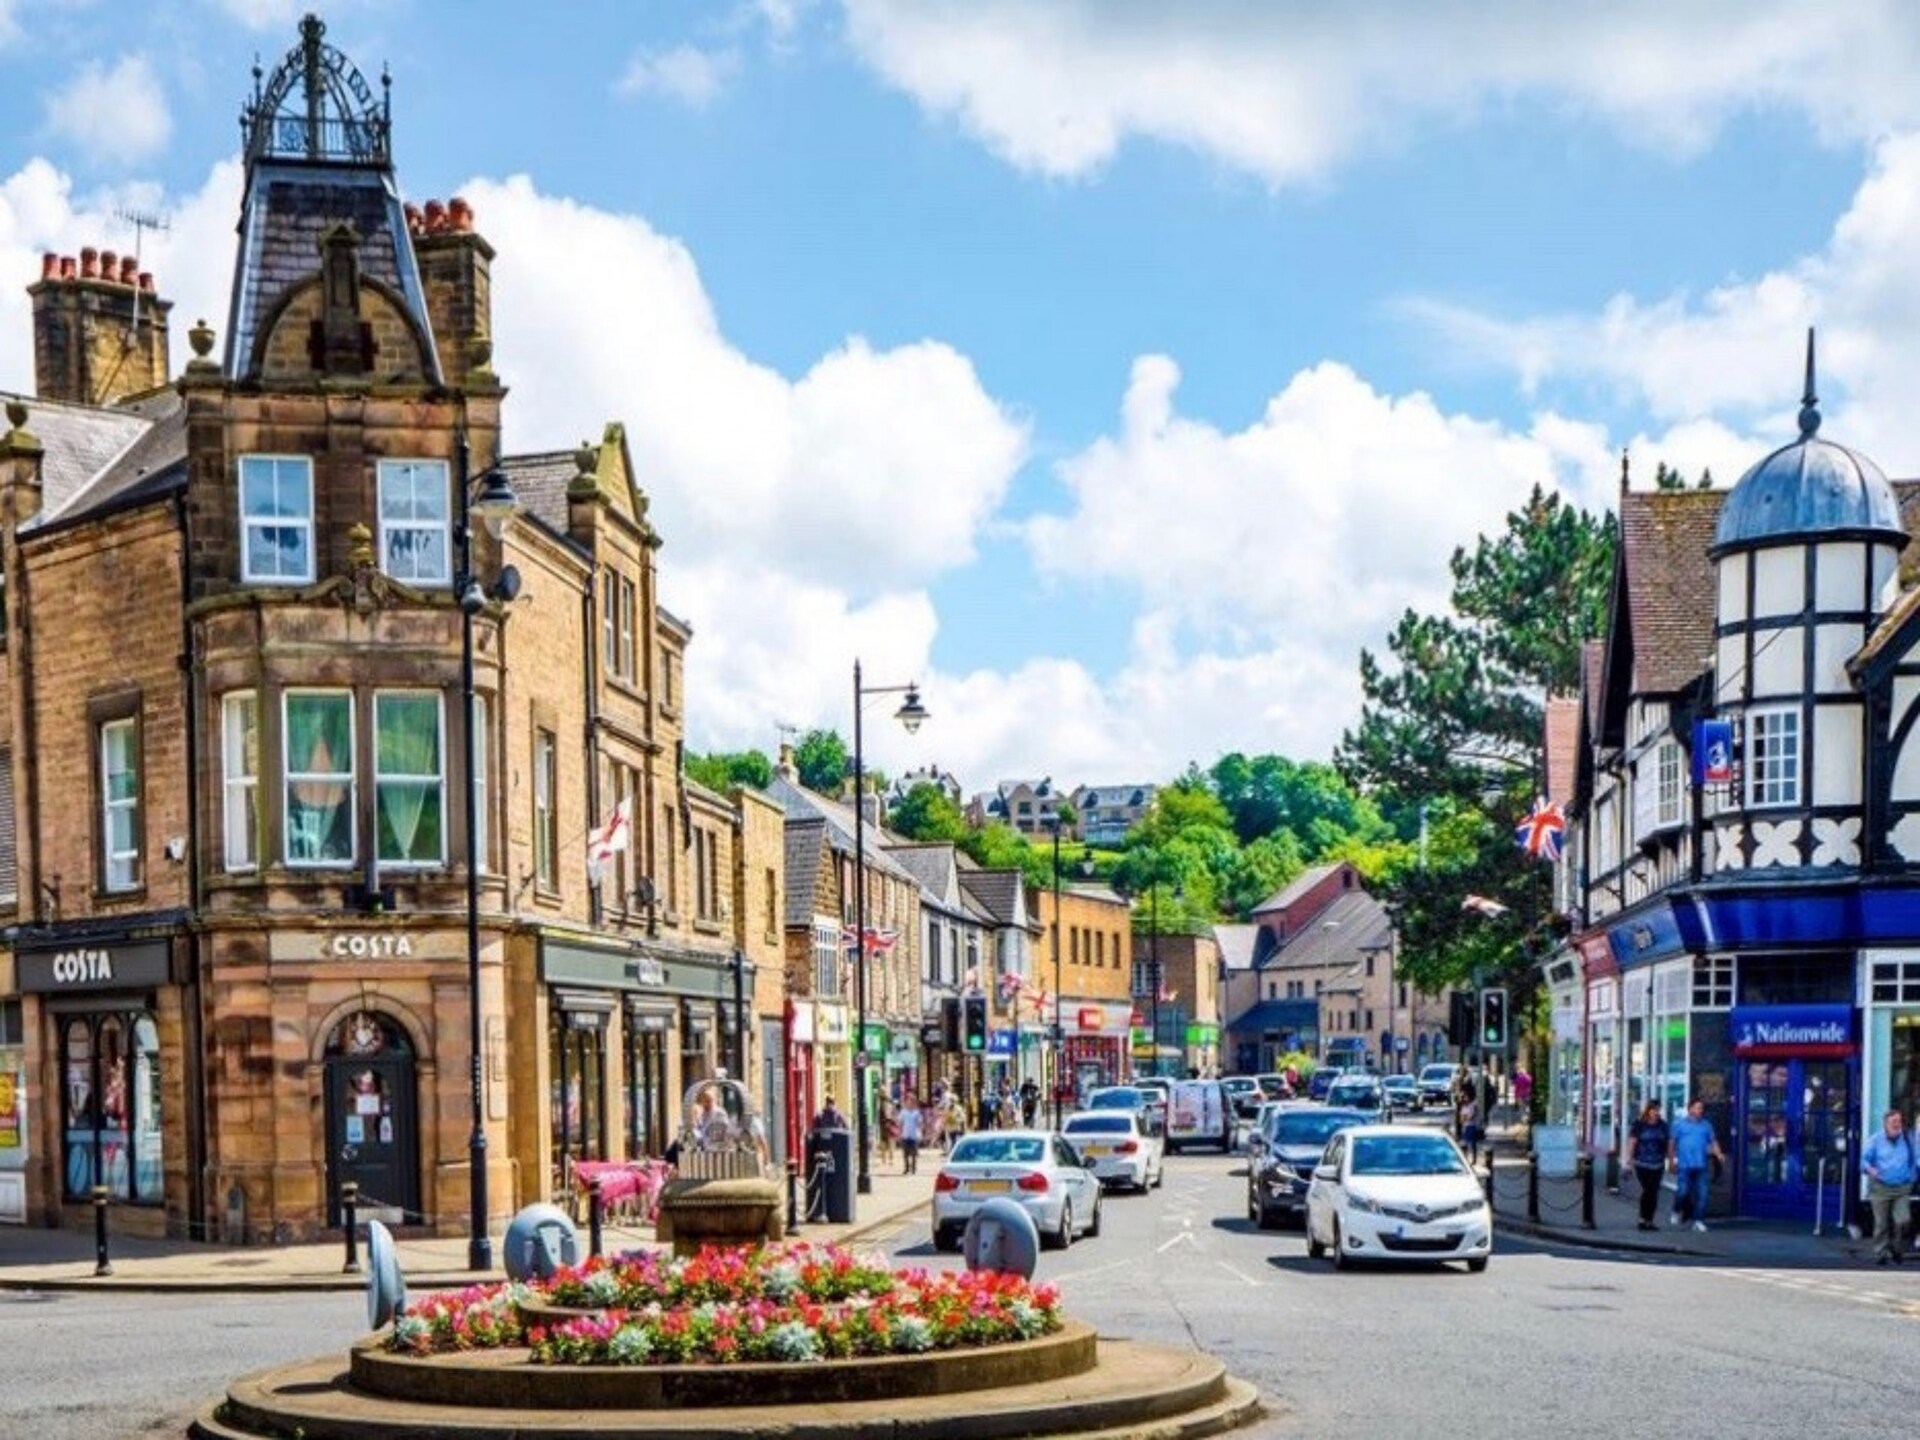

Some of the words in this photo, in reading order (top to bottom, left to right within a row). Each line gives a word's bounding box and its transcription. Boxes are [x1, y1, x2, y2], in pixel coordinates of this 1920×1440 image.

[332, 932, 412, 958] COSTA
[53, 948, 112, 983] COSTA
[1756, 1021, 1845, 1044] Nationwide
